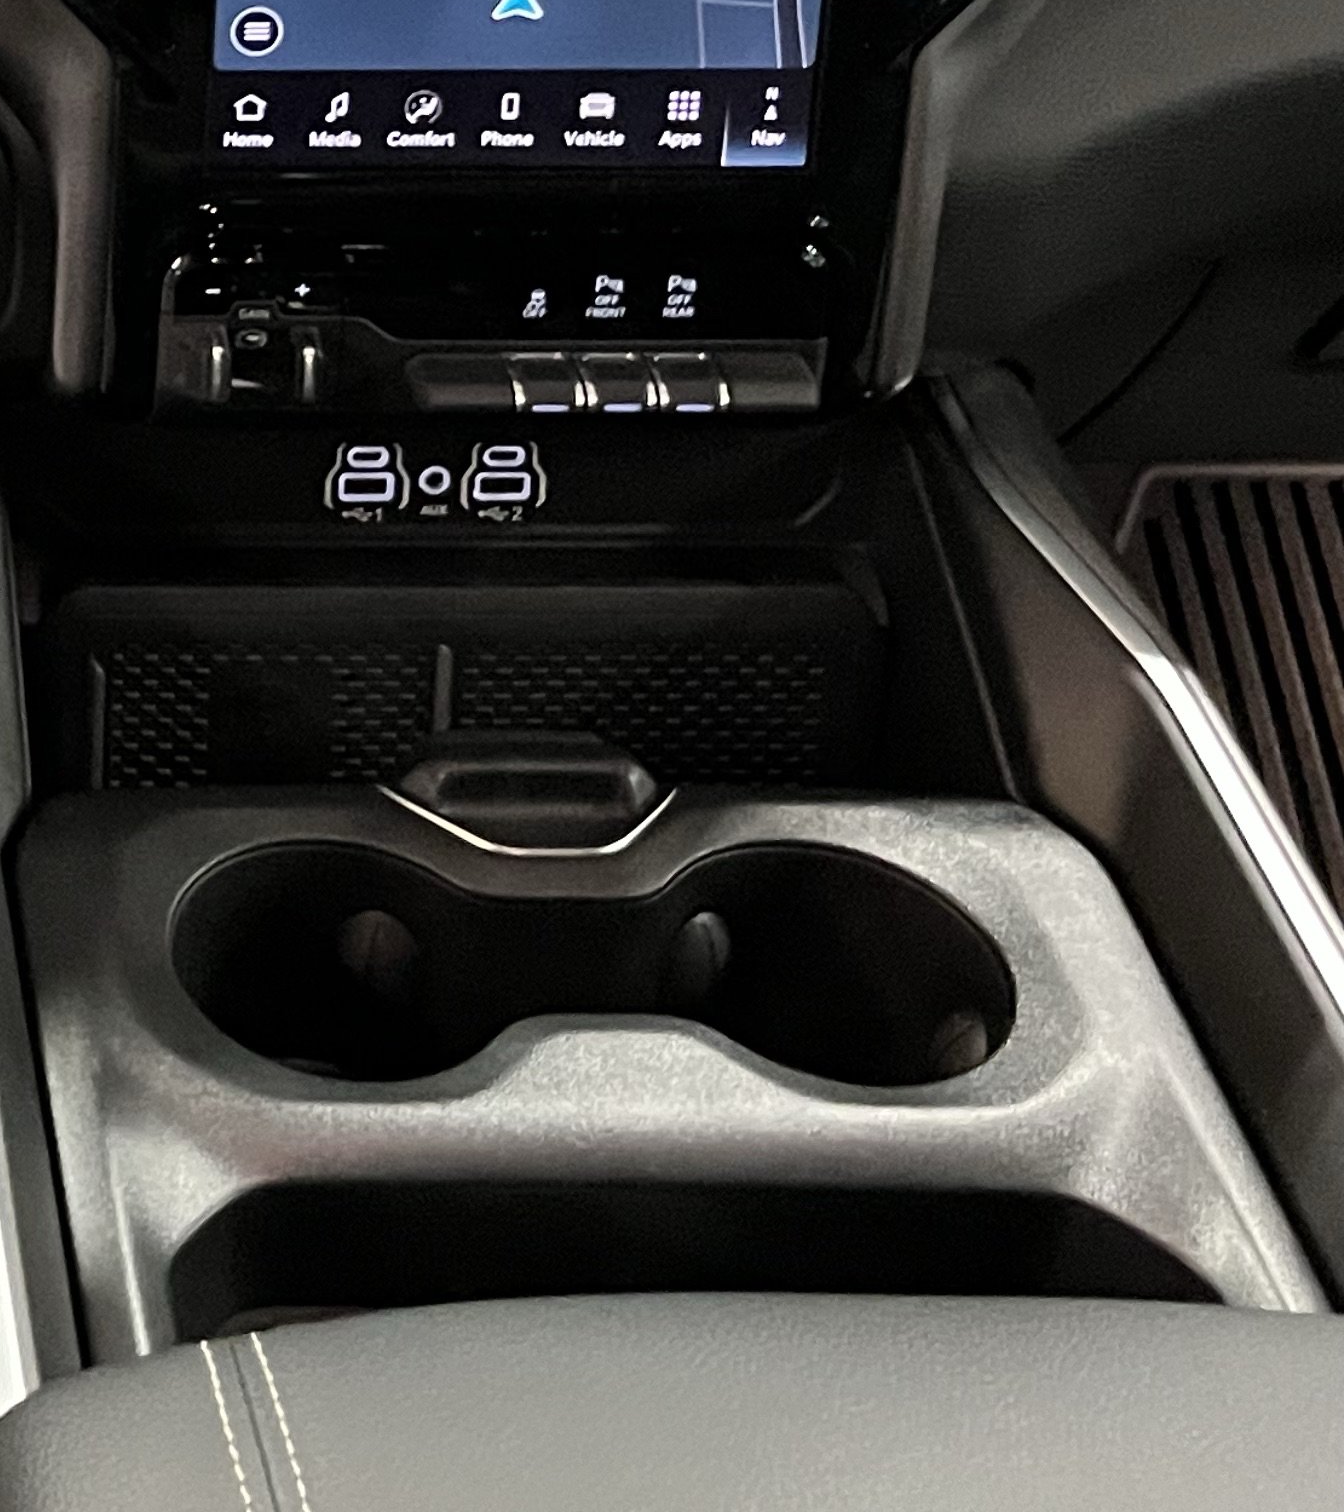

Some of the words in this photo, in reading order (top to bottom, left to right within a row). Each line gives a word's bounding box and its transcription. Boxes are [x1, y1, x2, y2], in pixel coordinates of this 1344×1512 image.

[223, 131, 274, 148] Home
[309, 130, 362, 148] Media
[387, 130, 455, 148] Comfort
[481, 130, 534, 148] Phone
[564, 130, 625, 148] Vehicle
[658, 130, 702, 149] Apps
[751, 129, 786, 147] Nav
[511, 506, 523, 522] 2
